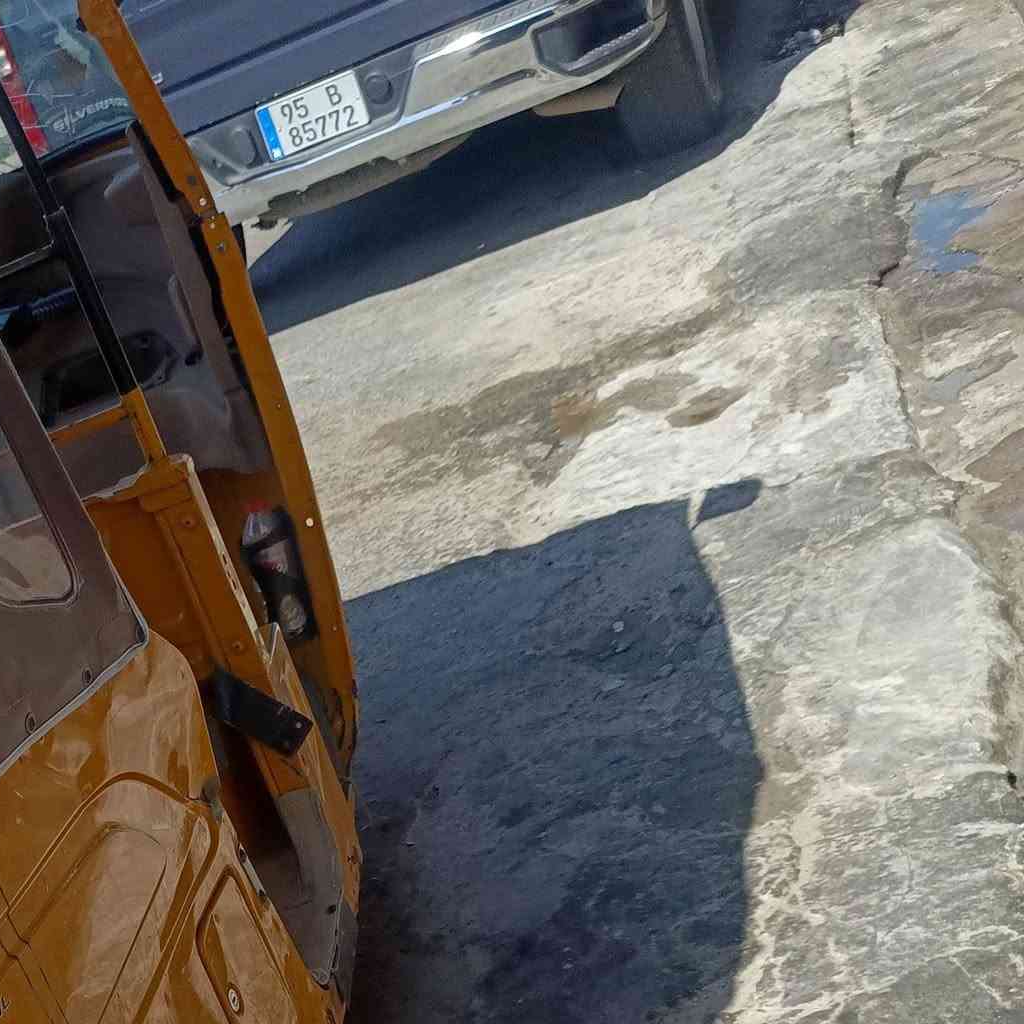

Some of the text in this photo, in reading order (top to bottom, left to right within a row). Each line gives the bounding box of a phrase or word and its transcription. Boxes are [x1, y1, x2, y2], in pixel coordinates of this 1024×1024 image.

[280, 84, 342, 124] 95 B
[288, 105, 358, 147] 85772
